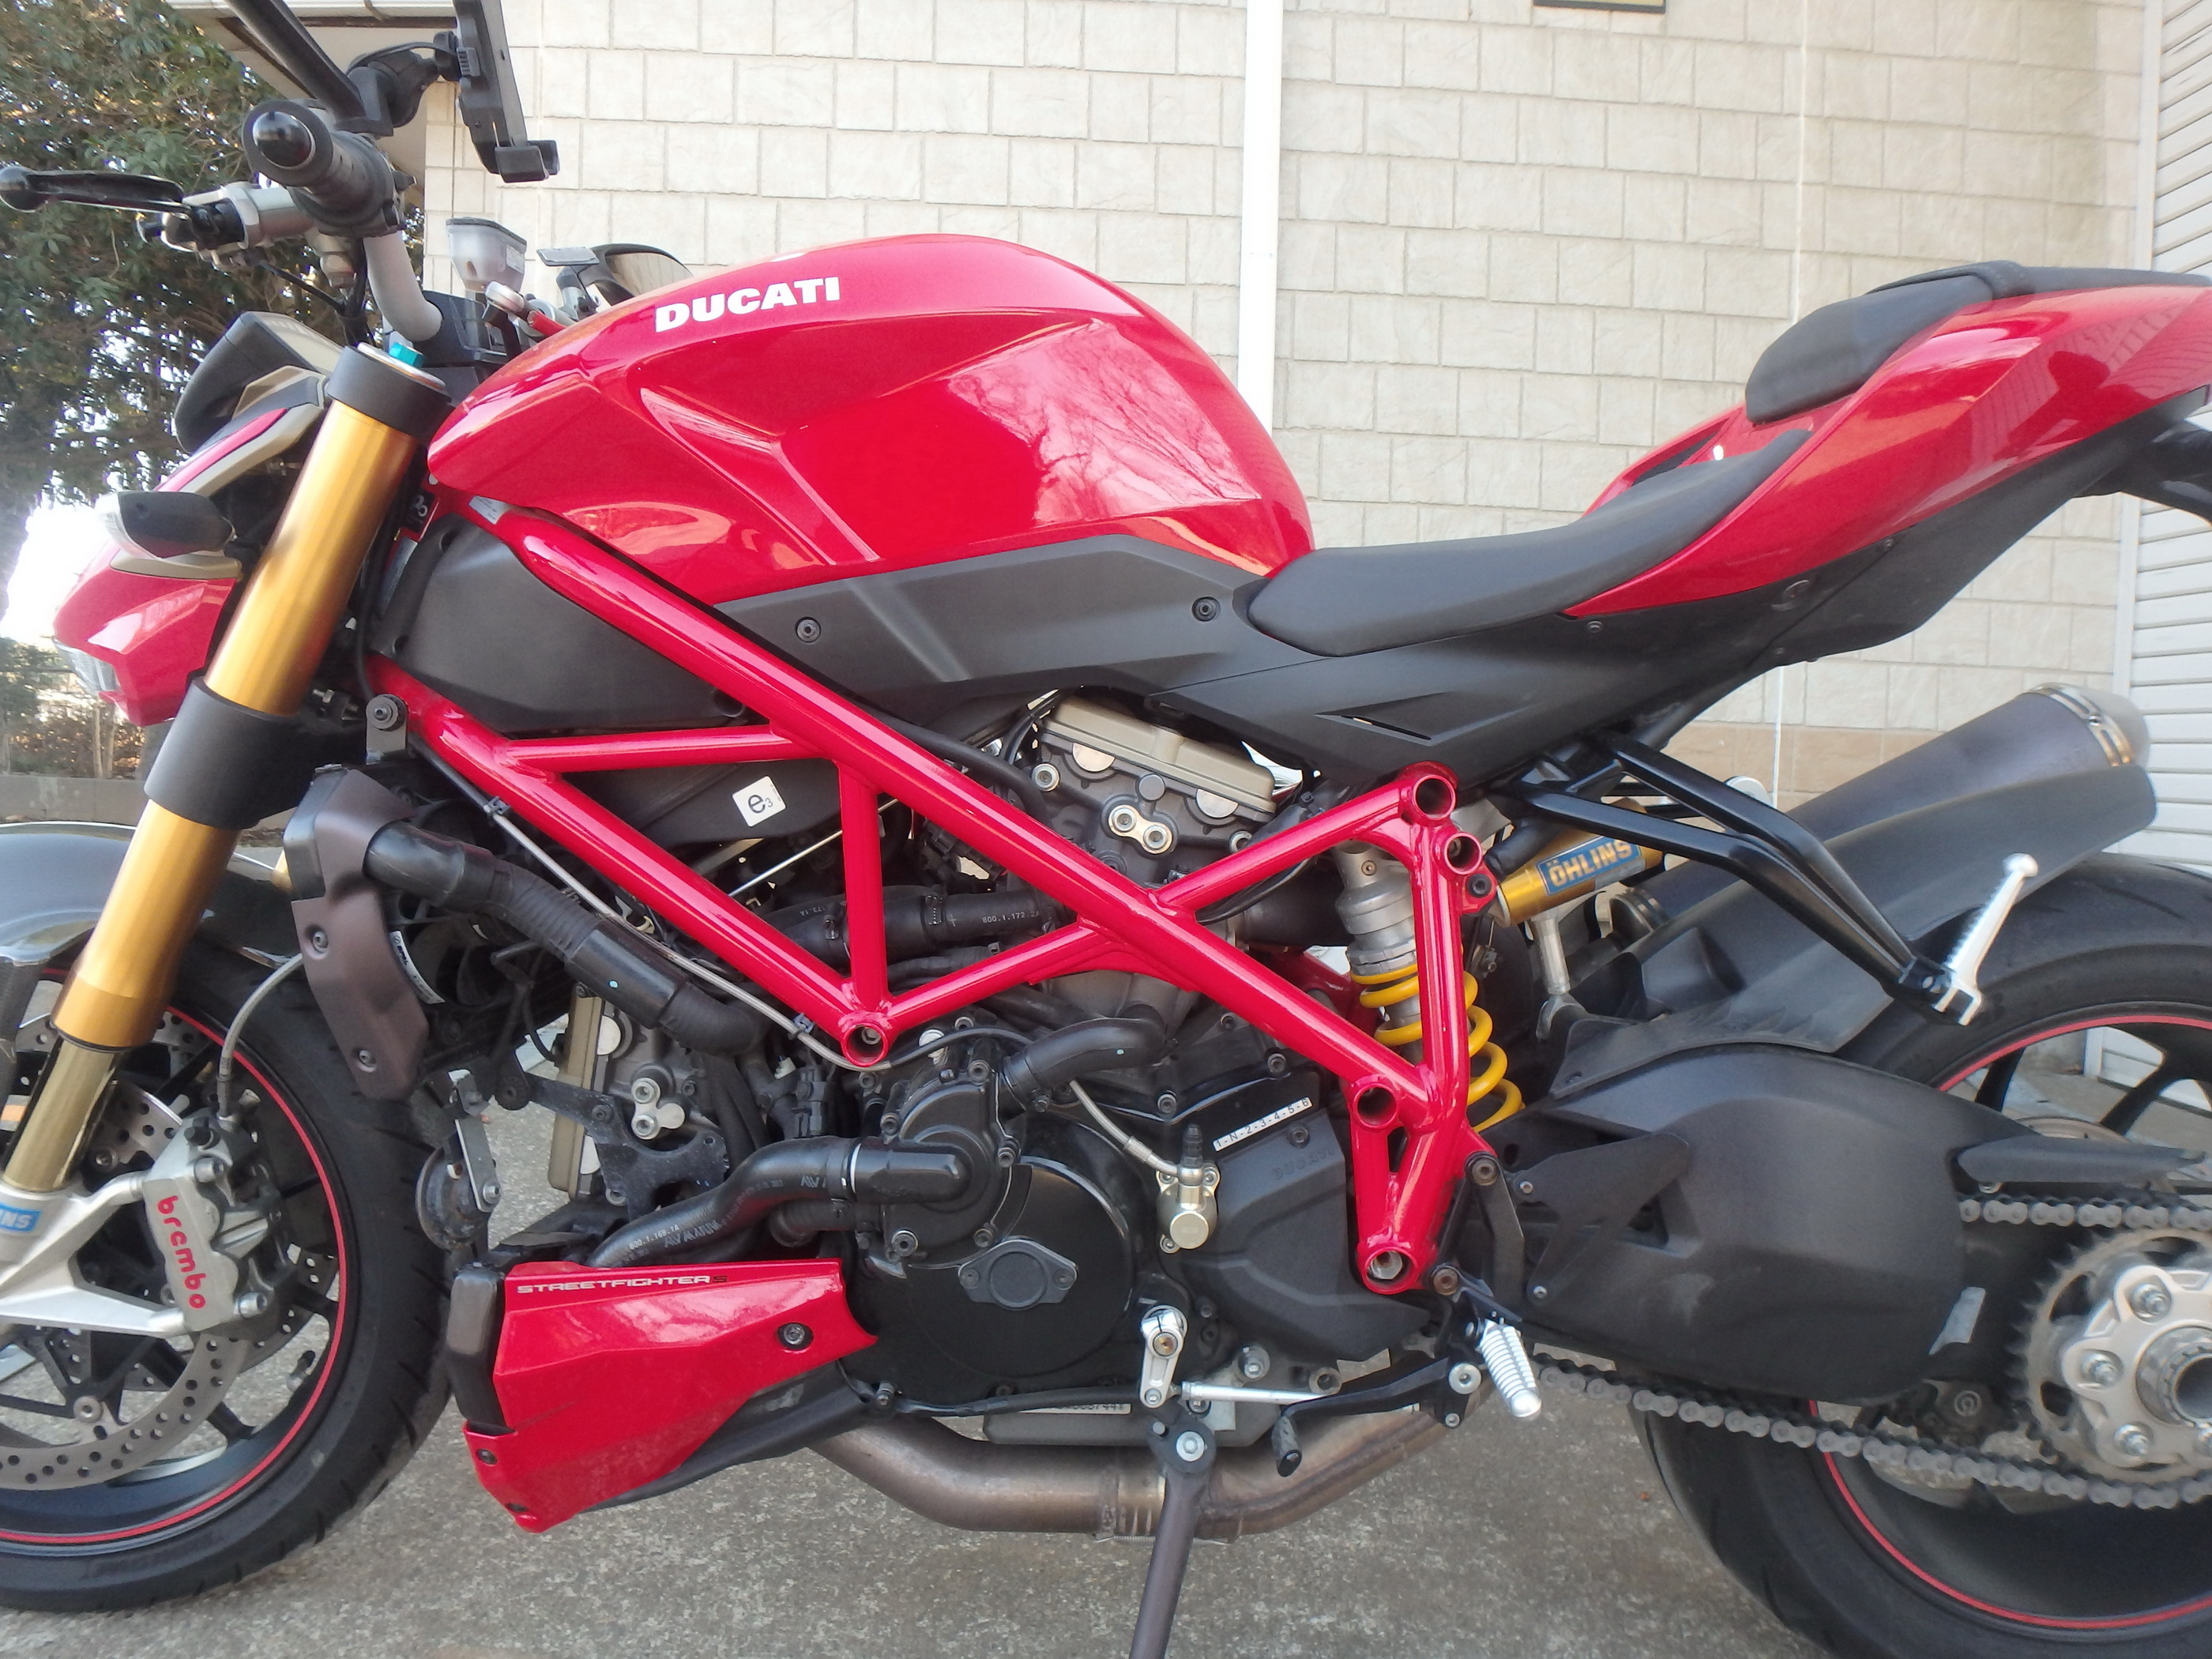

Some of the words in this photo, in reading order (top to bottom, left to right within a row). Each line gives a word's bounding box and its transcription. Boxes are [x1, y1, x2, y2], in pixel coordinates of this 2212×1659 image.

[655, 276, 841, 333] DUCATI
[157, 1195, 207, 1309] brembo
[517, 1275, 710, 1294] STREETFIGHTER
